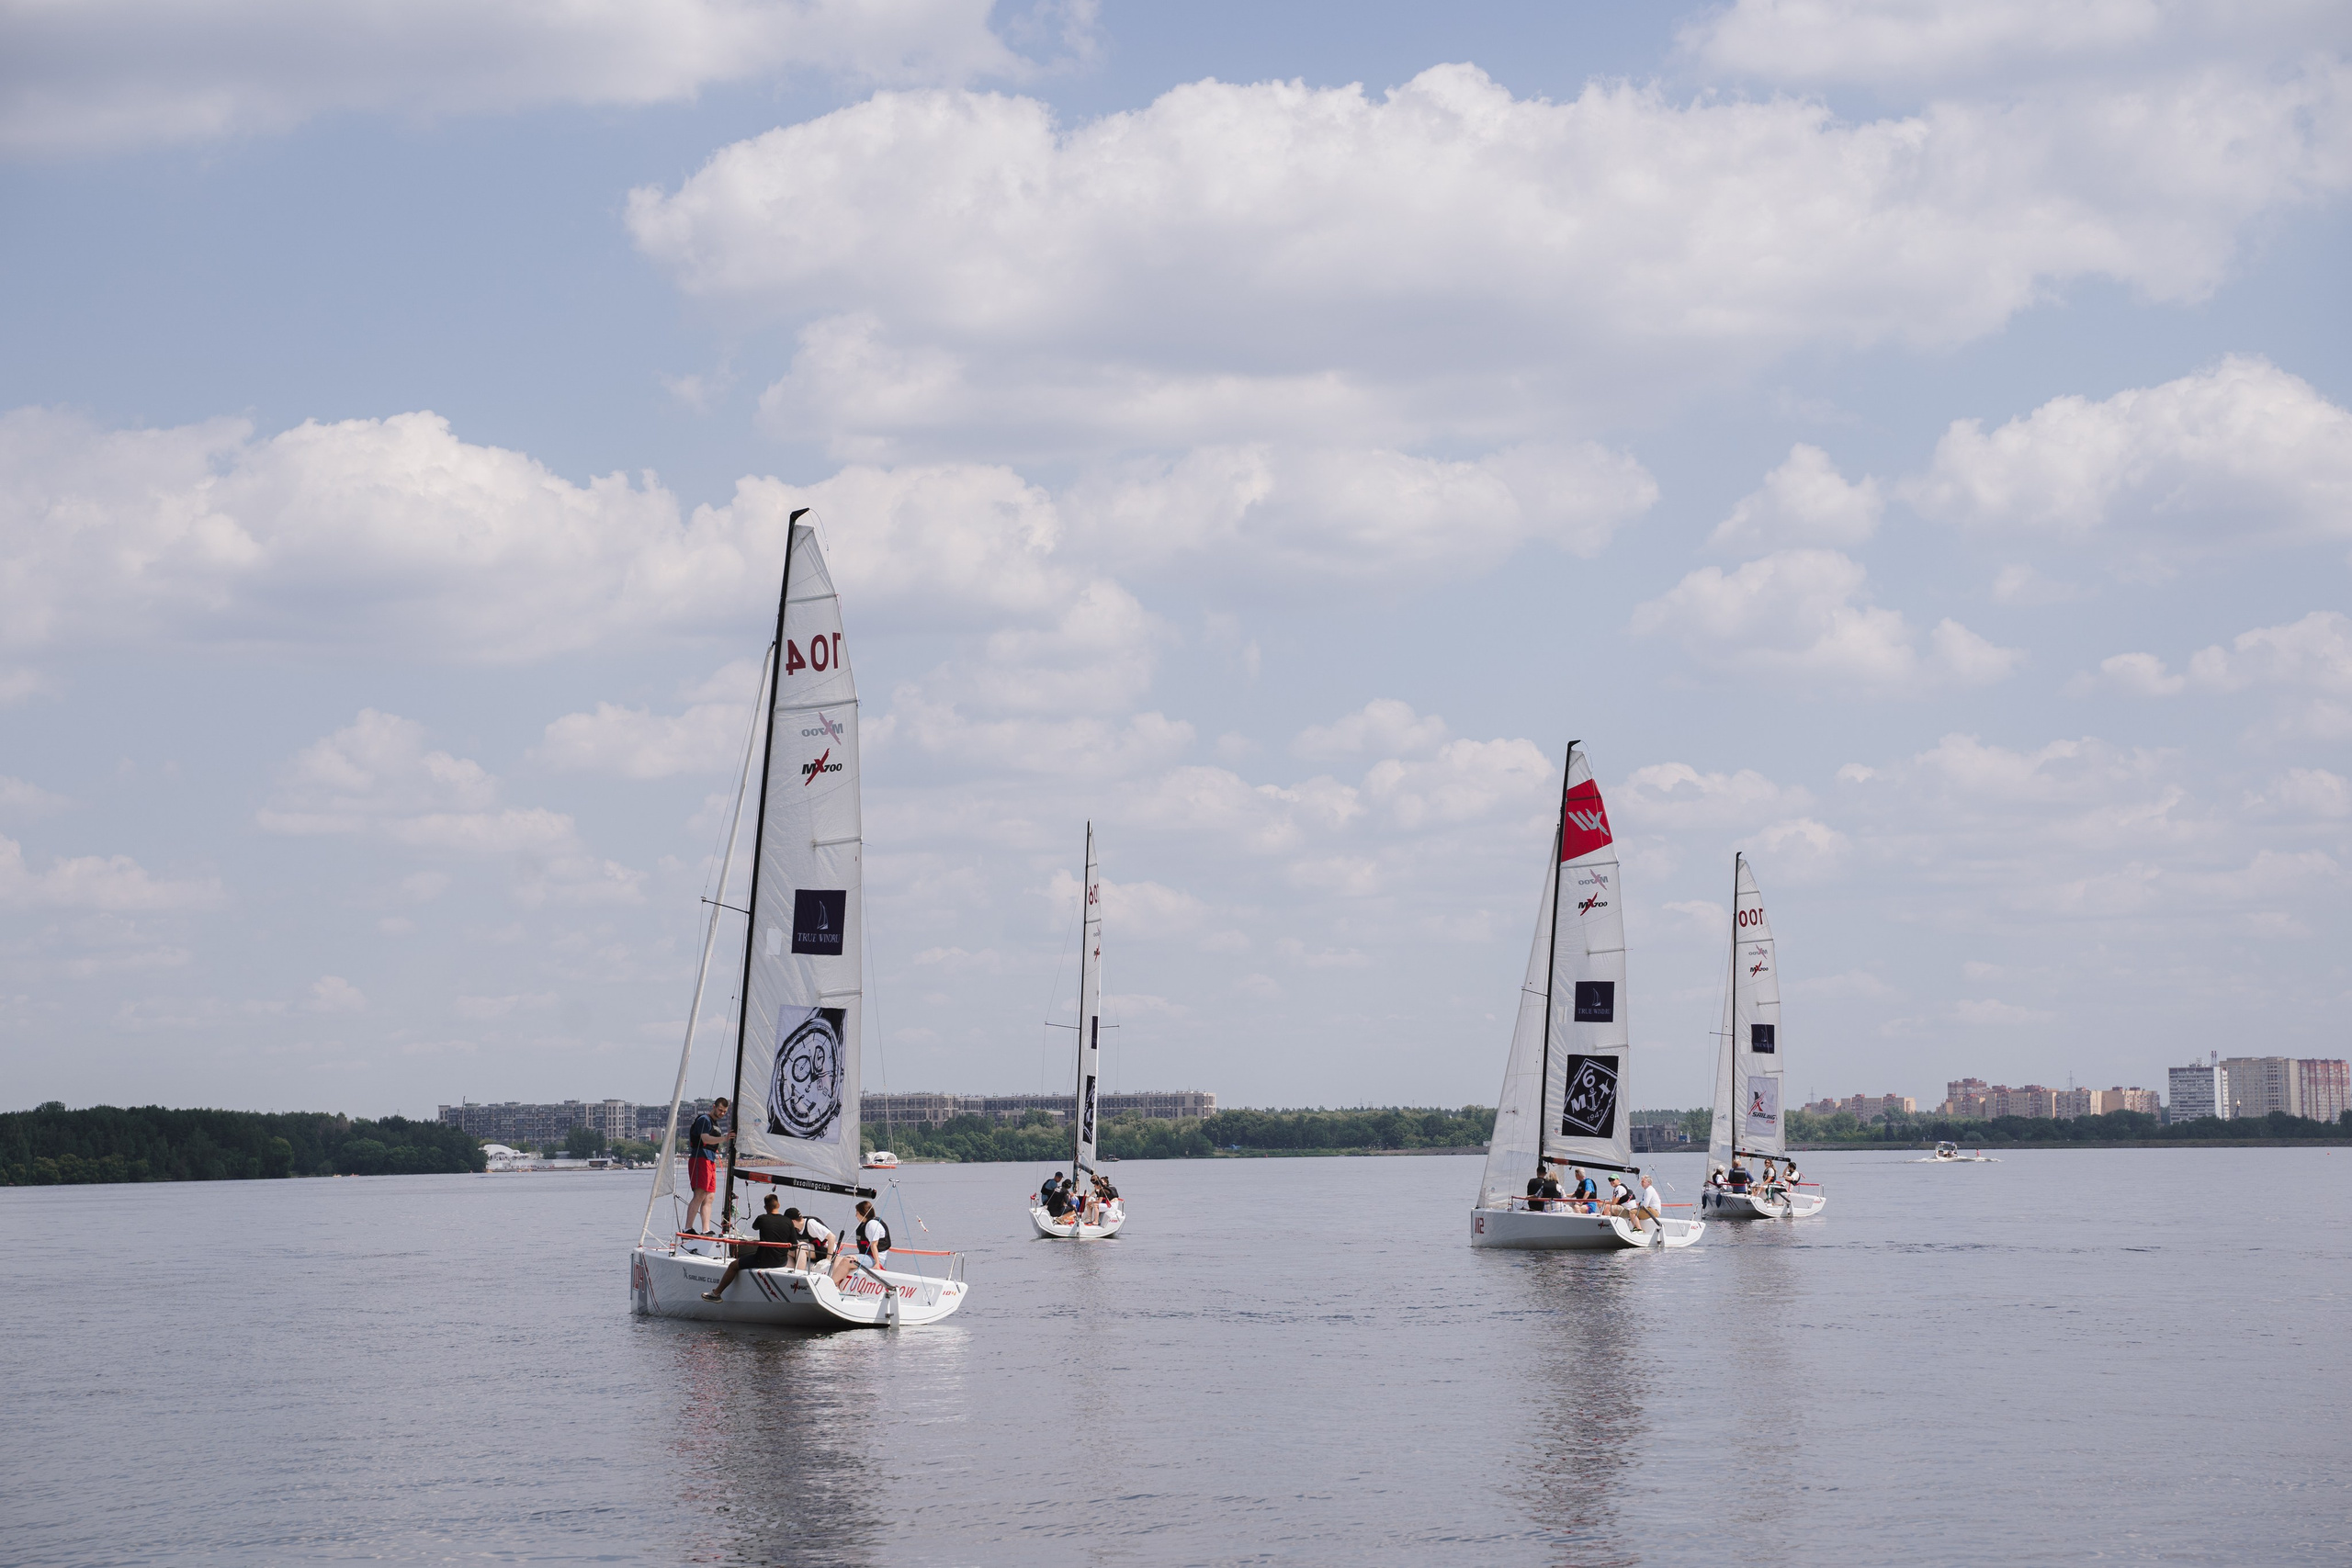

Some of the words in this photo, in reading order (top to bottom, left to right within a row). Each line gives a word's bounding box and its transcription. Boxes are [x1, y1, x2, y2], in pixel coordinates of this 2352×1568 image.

[797, 932, 817, 942] TRUE
[1582, 1068, 1596, 1089] 6
[1587, 1108, 1604, 1122] 1947
